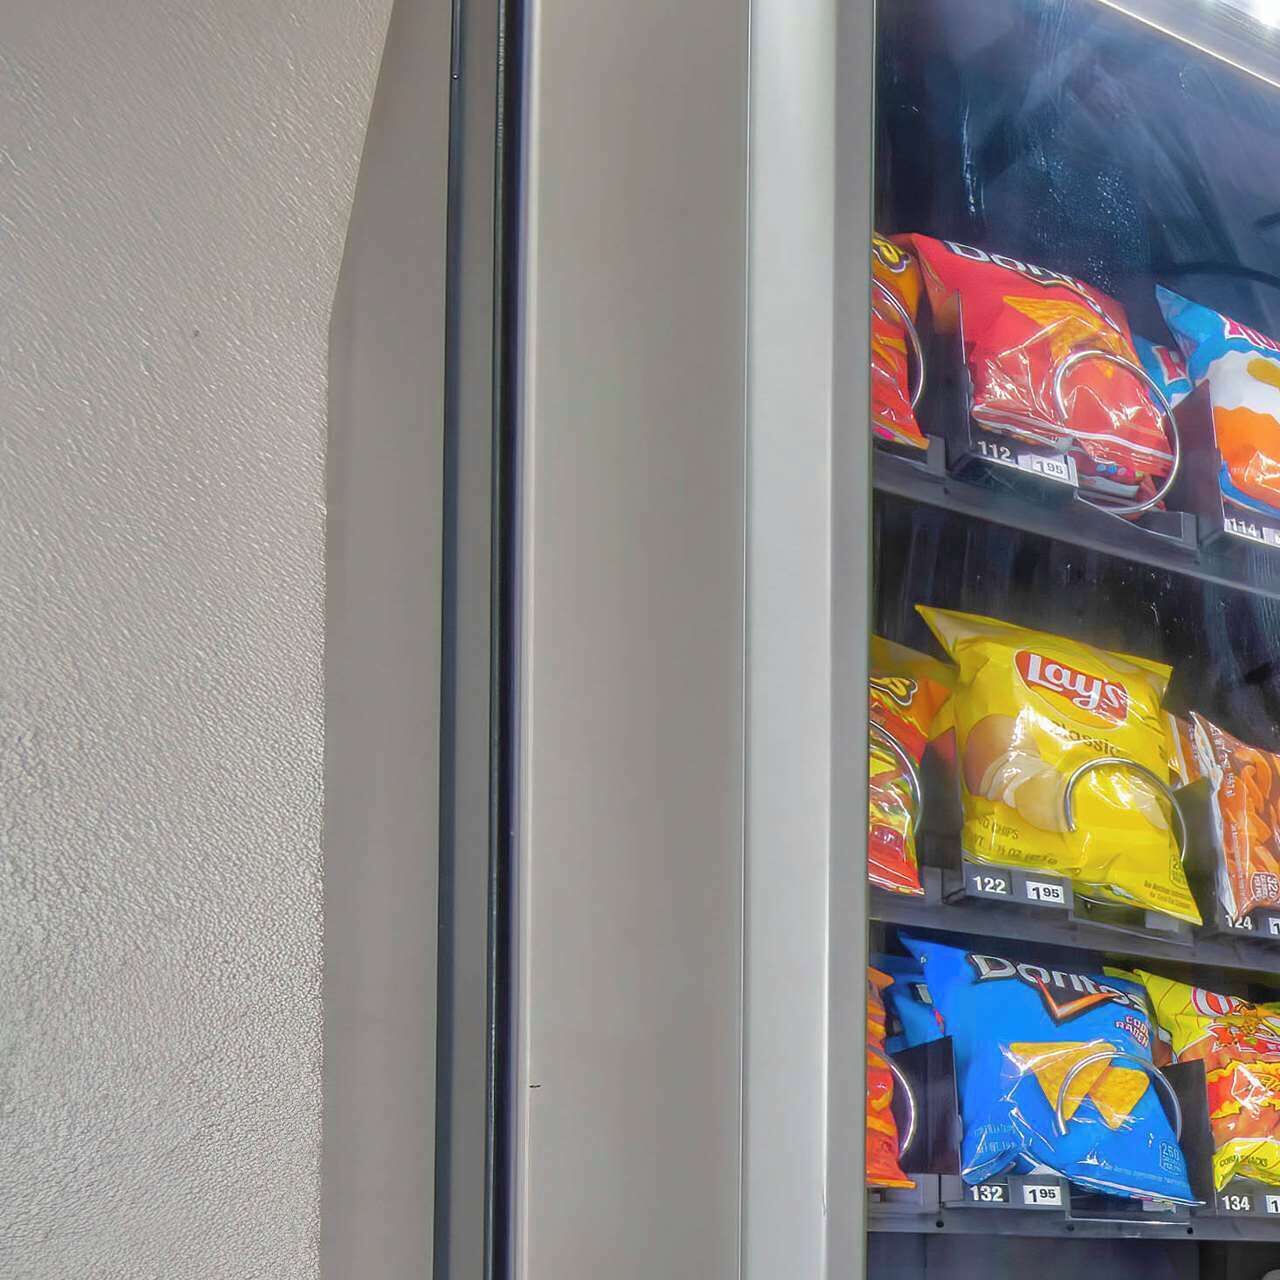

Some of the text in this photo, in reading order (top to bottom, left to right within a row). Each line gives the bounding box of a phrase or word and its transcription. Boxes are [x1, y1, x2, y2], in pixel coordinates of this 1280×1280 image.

[978, 441, 1011, 460] 112
[1028, 654, 1129, 708] Lay's
[973, 876, 1007, 894] 122
[1225, 915, 1252, 930] 124
[971, 954, 1147, 1015] Doritos
[970, 1186, 1004, 1203] 132
[1222, 1195, 1250, 1211] 134
